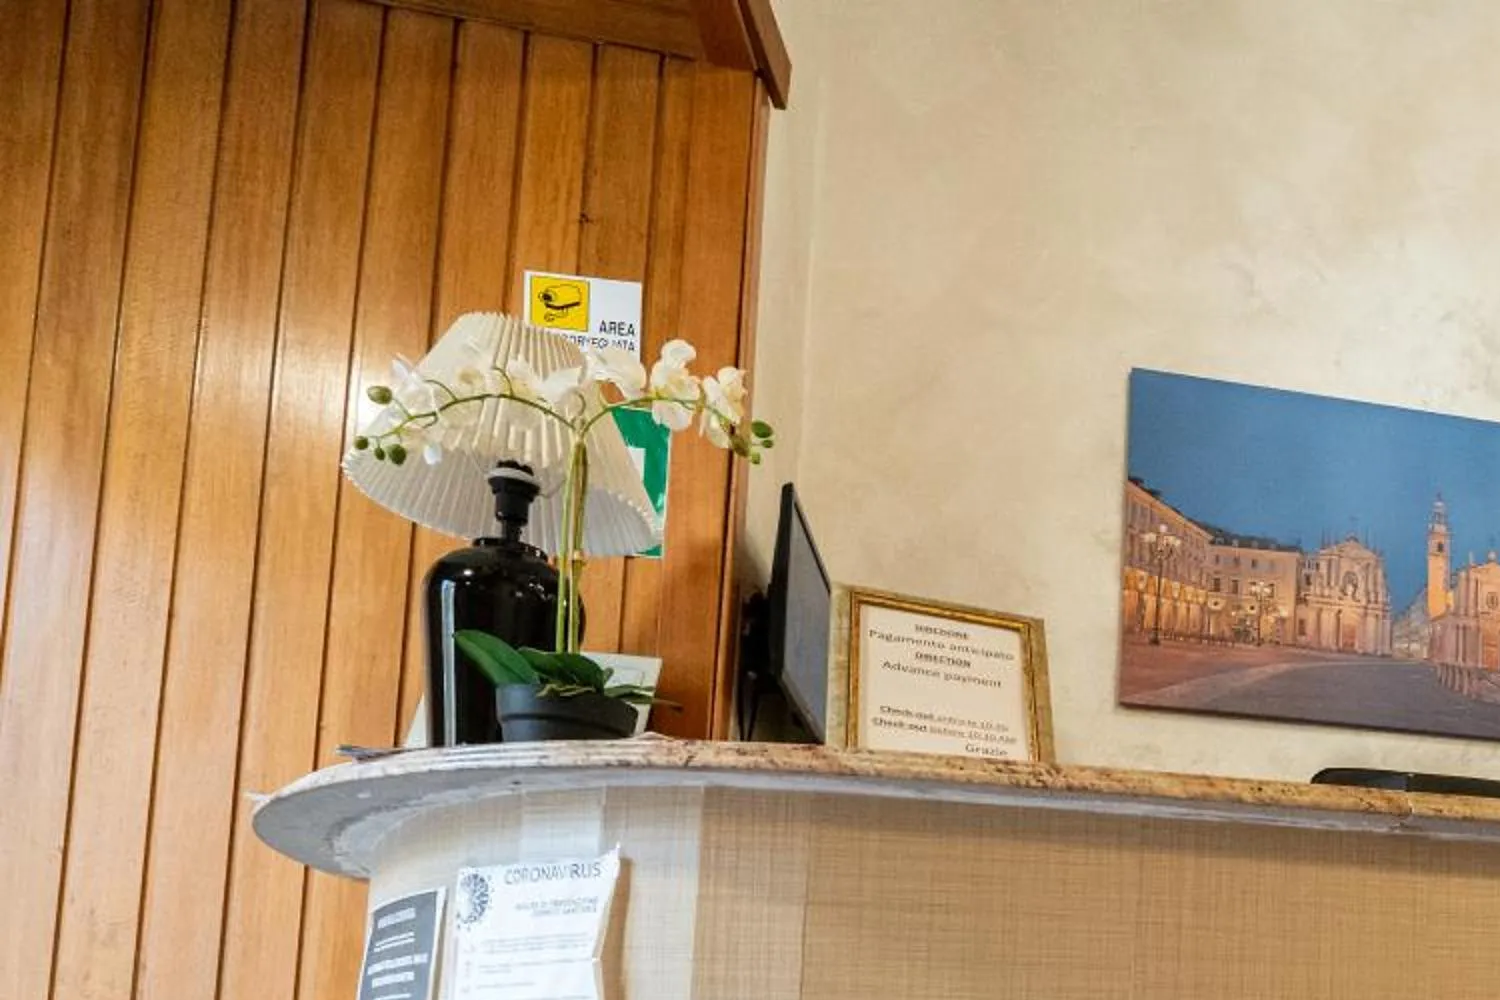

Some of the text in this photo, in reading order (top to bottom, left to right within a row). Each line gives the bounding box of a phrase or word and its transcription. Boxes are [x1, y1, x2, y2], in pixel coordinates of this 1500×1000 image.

[599, 320, 635, 337] AREA
[868, 629, 946, 650] Pagamento
[881, 660, 1002, 690] Advance payment
[505, 861, 602, 886] CORONAVIRUS
